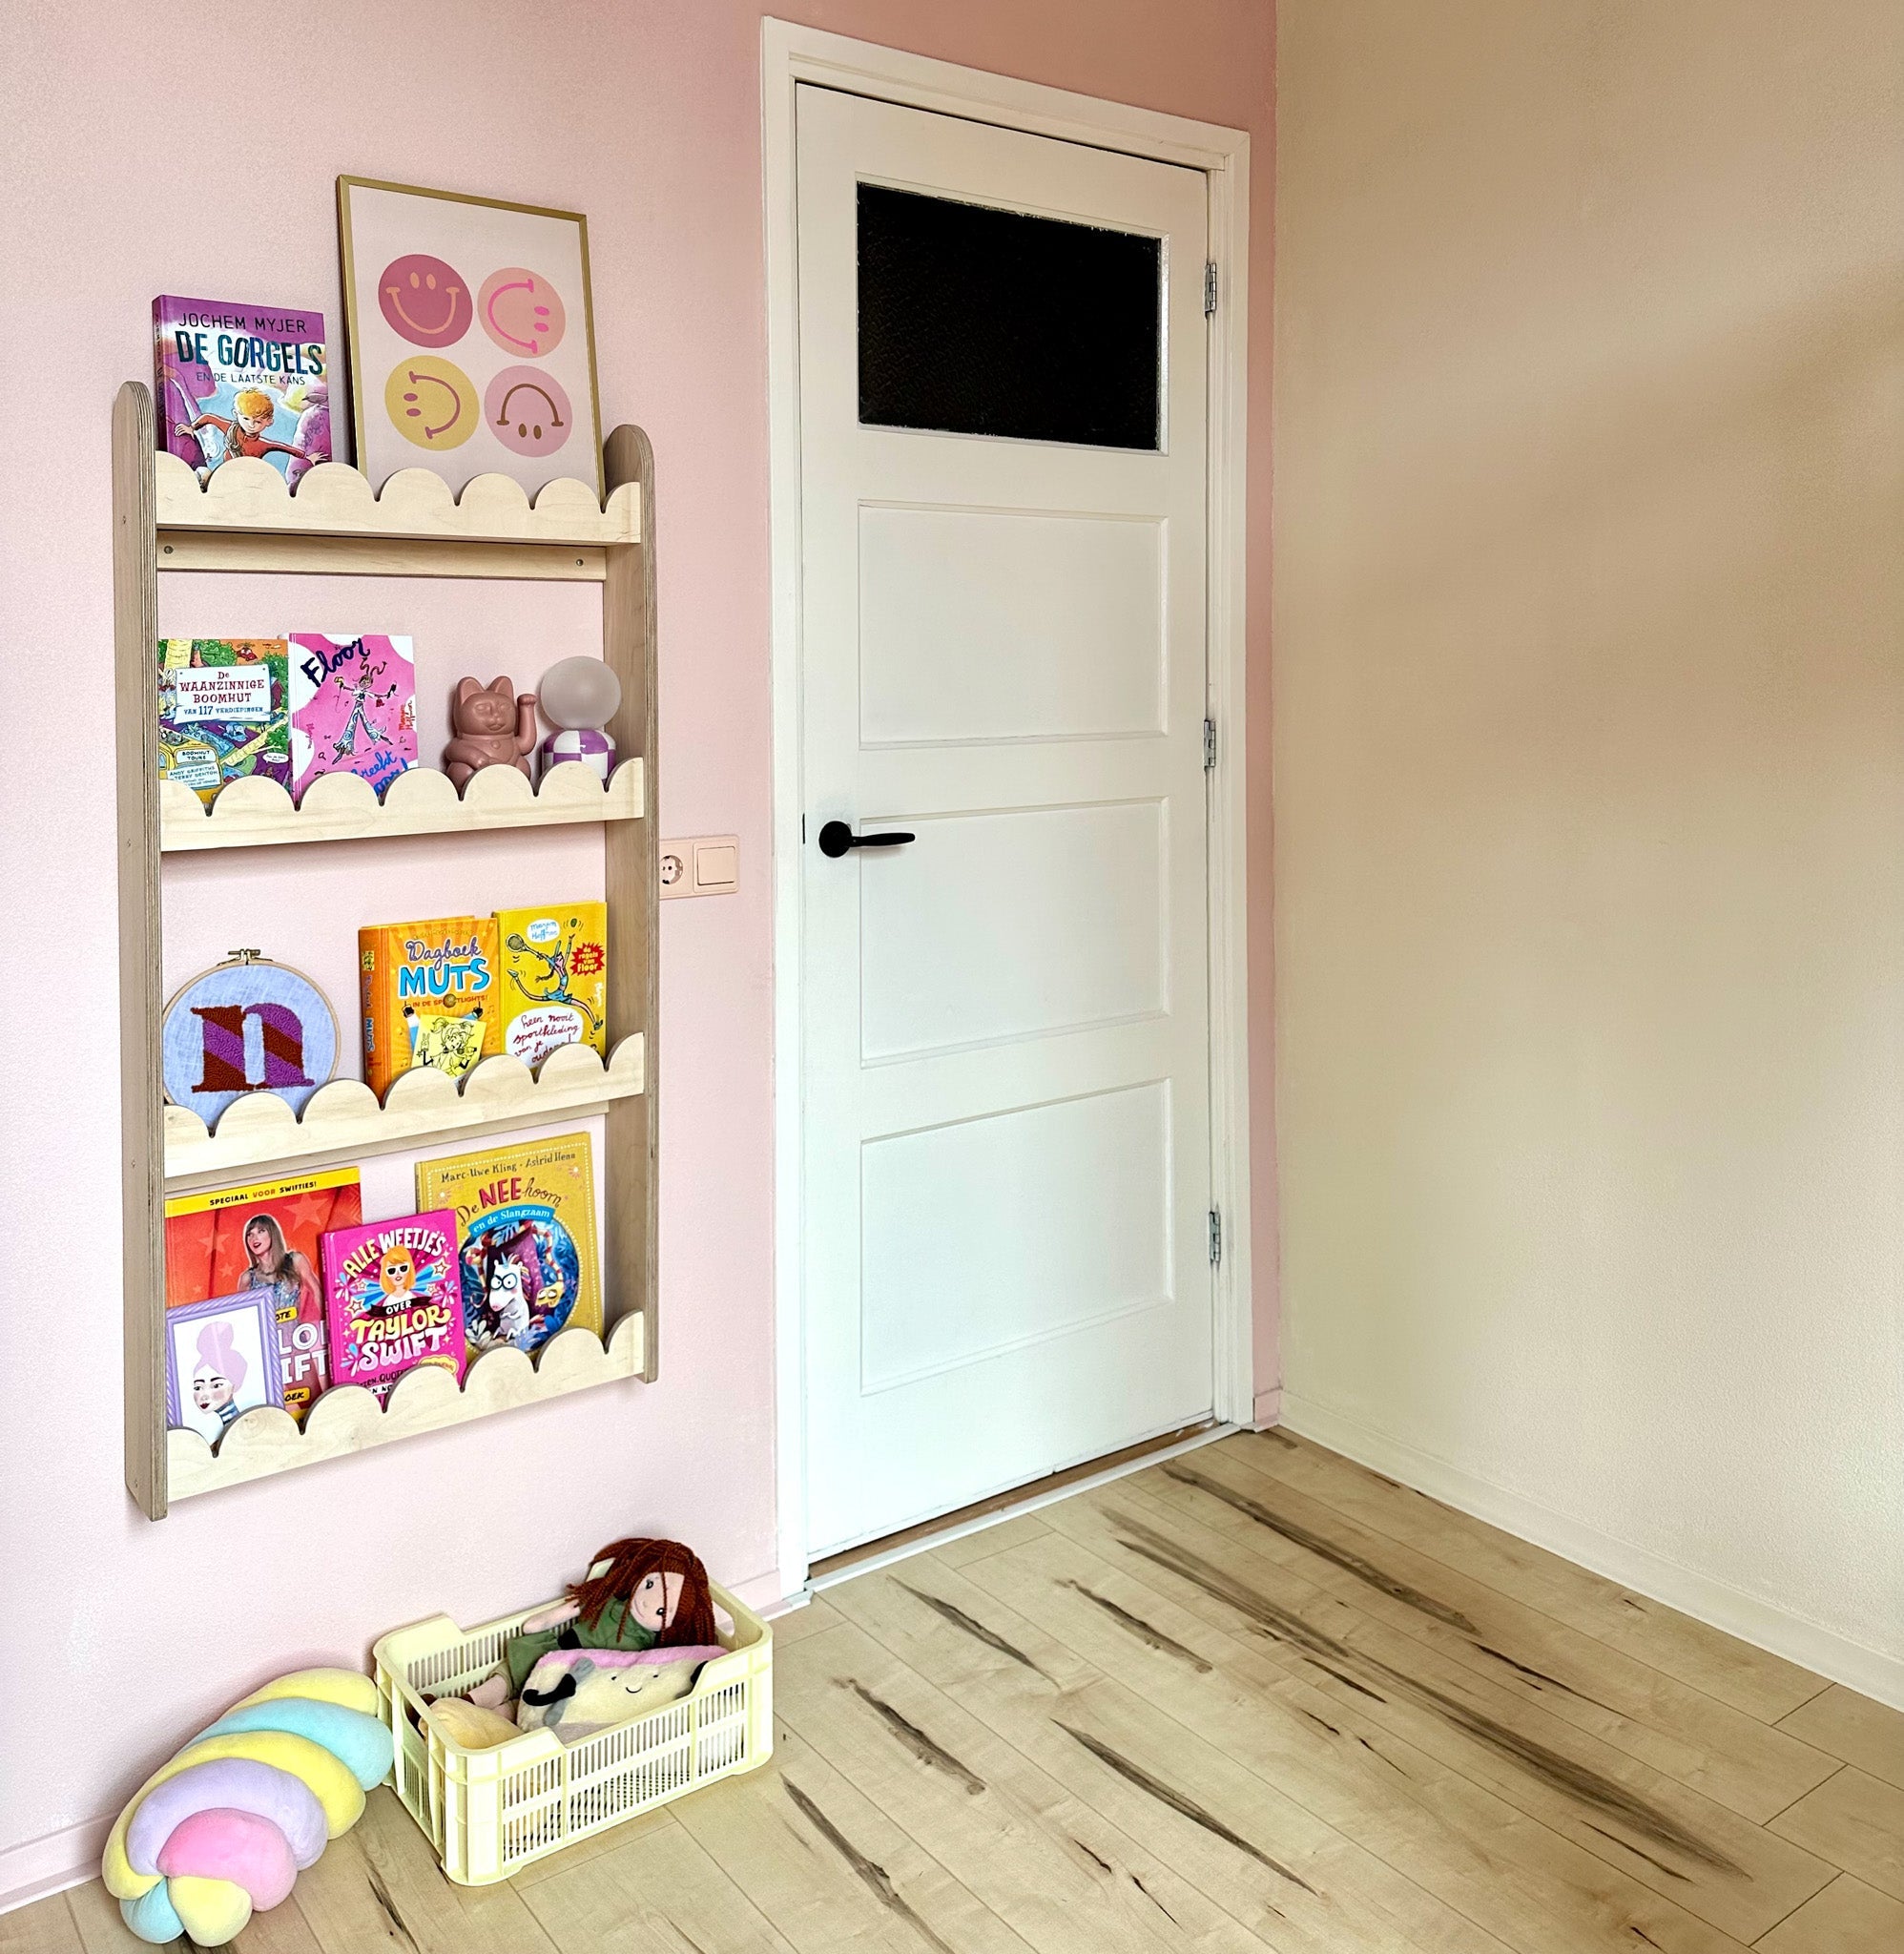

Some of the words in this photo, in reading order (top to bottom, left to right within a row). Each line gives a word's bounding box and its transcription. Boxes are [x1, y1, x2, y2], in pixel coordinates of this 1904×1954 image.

[178, 312, 246, 330] JOCHEM
[255, 317, 307, 333] MYJER
[175, 330, 209, 365] DE
[217, 334, 323, 375] GORGELS
[197, 371, 213, 382] EN
[214, 372, 227, 383] DE
[231, 373, 276, 385] LAATSTE
[279, 376, 306, 385] KANS
[300, 637, 371, 687] Floor
[178, 679, 264, 692] WAANZINNIGE
[217, 671, 230, 679] De
[193, 693, 252, 704] BOOMHUT
[198, 705, 213, 715] 117
[405, 936, 482, 971] Dagboek
[400, 958, 490, 996] MUTS
[492, 1163, 518, 1174] Kling
[209, 1194, 249, 1206] SPECIAAL
[253, 1188, 276, 1198] VOOR
[279, 1181, 317, 1194] SWIFTIES!
[456, 1204, 480, 1228] De
[501, 1208, 550, 1220] Slangzaam
[342, 1238, 381, 1278] ALLE
[385, 1299, 412, 1316] OVER
[349, 1304, 452, 1343] TAYLOR
[359, 1327, 448, 1372] SWIFT
